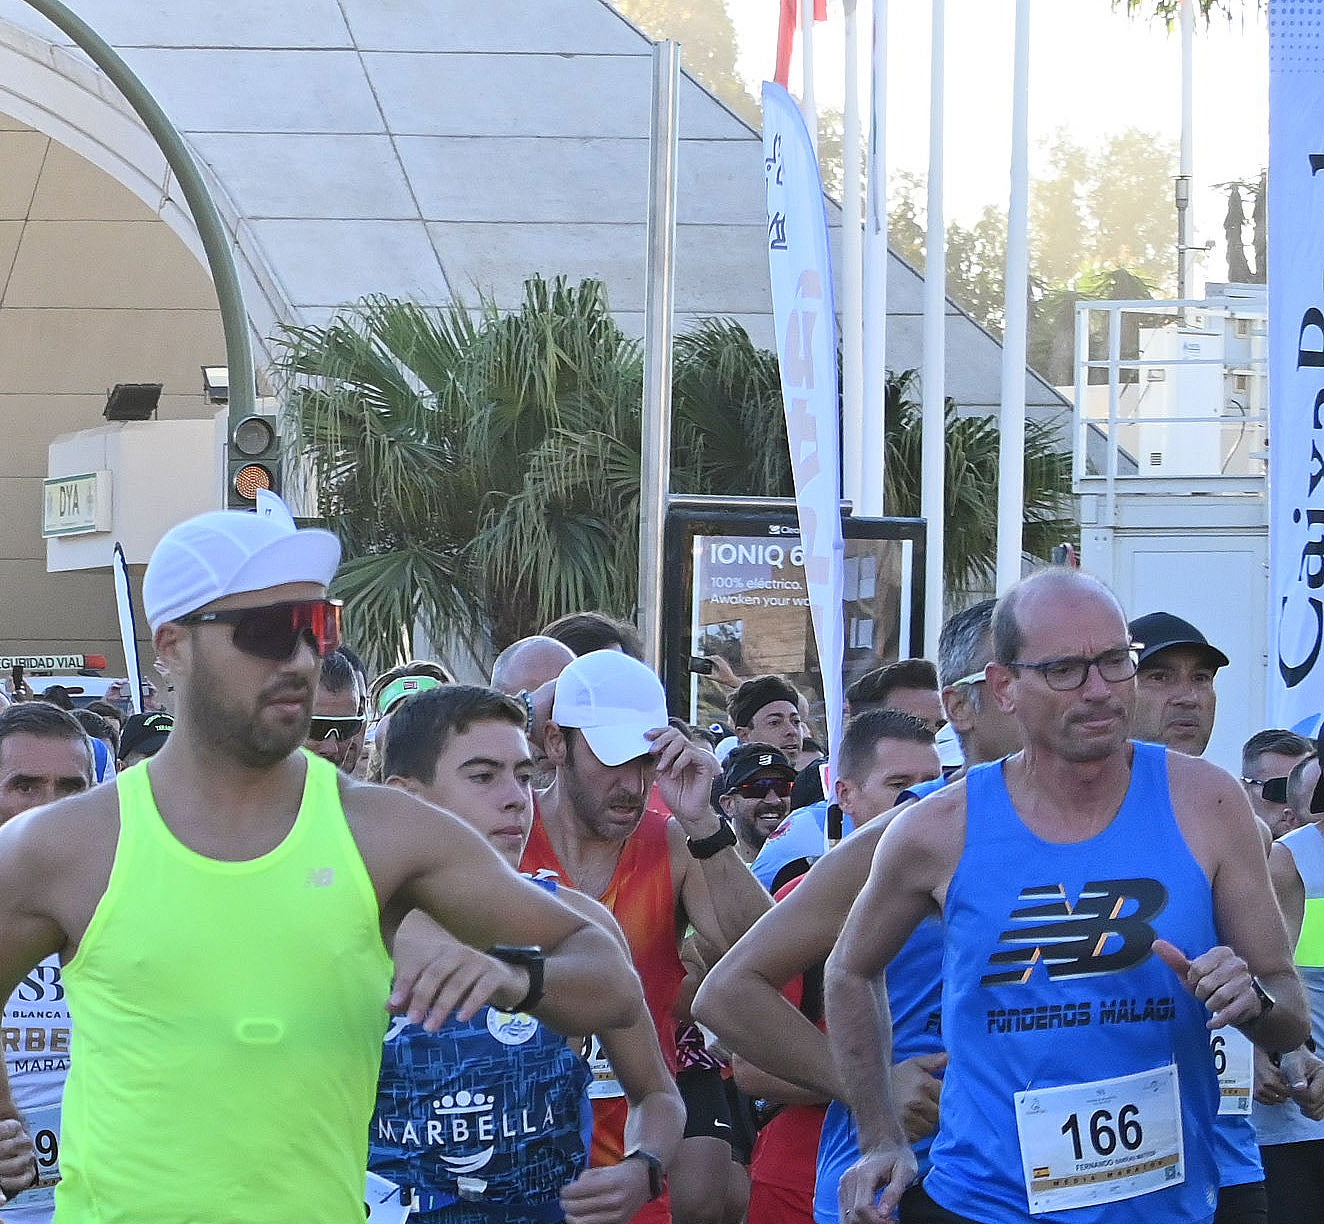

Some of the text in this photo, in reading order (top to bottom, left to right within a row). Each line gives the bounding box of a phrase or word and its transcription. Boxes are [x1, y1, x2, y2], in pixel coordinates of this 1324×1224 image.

[59, 484, 79, 517] DYA
[710, 543, 784, 568] IONIQ
[712, 577, 802, 590] 100% eléctrico.
[711, 594, 760, 605] Awaken
[764, 598, 790, 608] your
[56, 657, 85, 668] VIAL
[13, 1011, 61, 1019] BLANCA
[378, 1105, 554, 1145] MARBELLA
[1061, 1104, 1143, 1160] 166
[1075, 1158, 1113, 1171] FERNANDO
